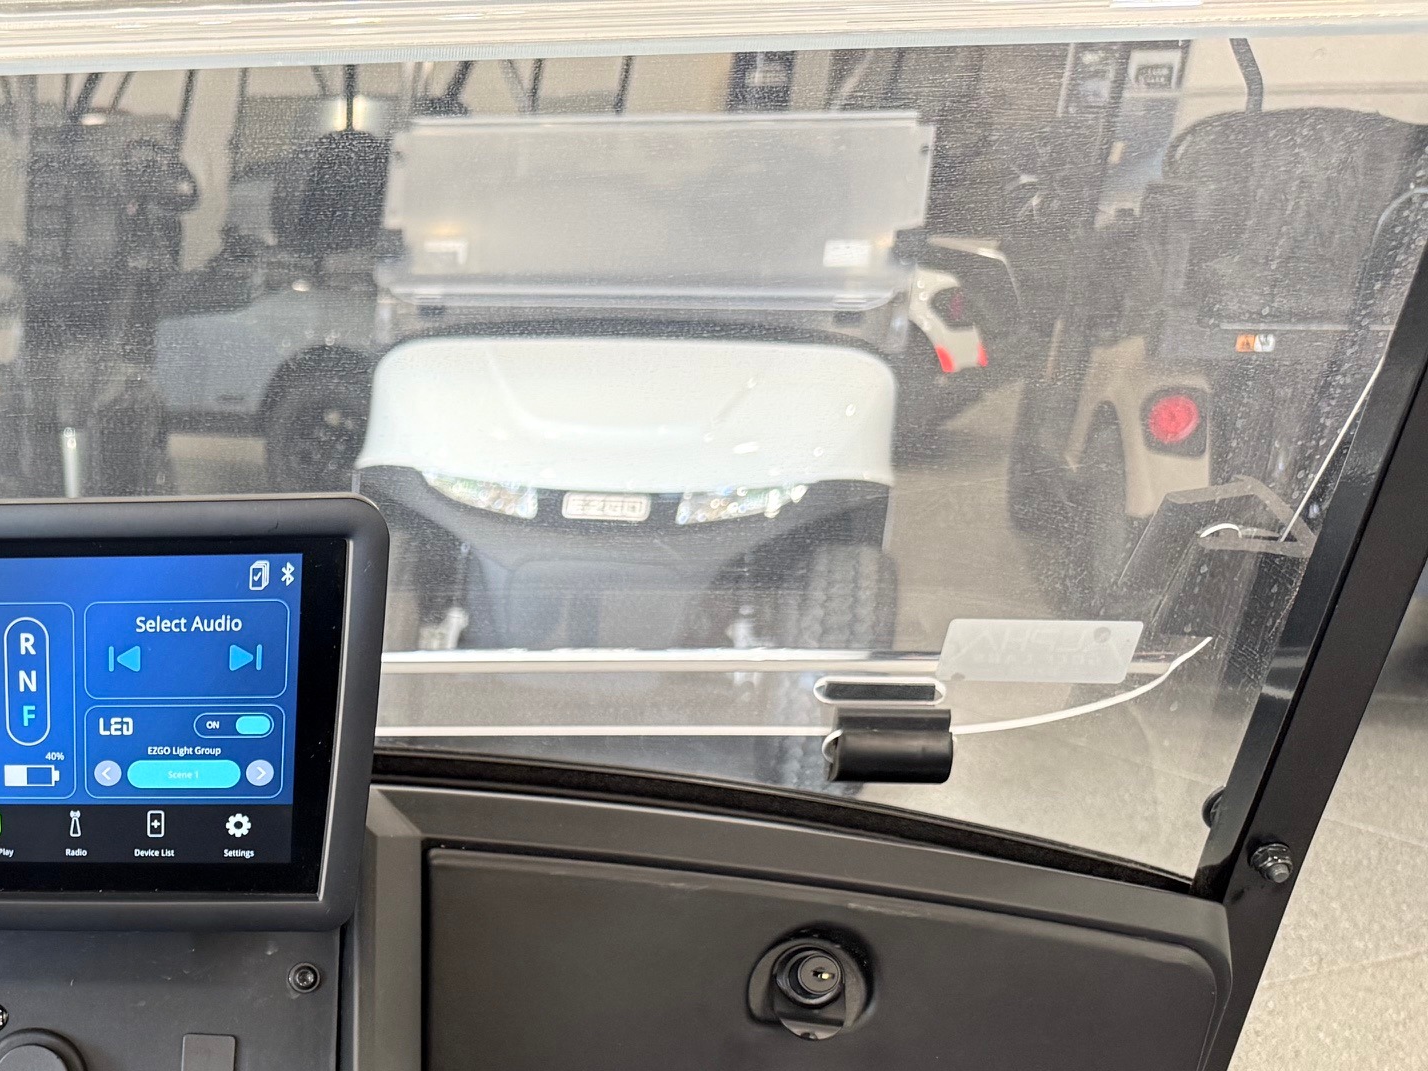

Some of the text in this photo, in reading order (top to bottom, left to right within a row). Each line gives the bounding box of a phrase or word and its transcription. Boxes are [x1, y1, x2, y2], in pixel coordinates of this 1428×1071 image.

[135, 614, 243, 632] Select Audio
[19, 633, 37, 655] R
[18, 670, 37, 692] N
[22, 705, 36, 727] F
[98, 717, 134, 736] LED
[206, 720, 220, 729] ON
[45, 751, 65, 762] 40%
[147, 746, 221, 757] EZGO Light Group
[167, 770, 200, 780] Scene 1
[65, 848, 88, 857] Radio
[134, 848, 175, 857] Device List
[223, 848, 255, 859] Settings
